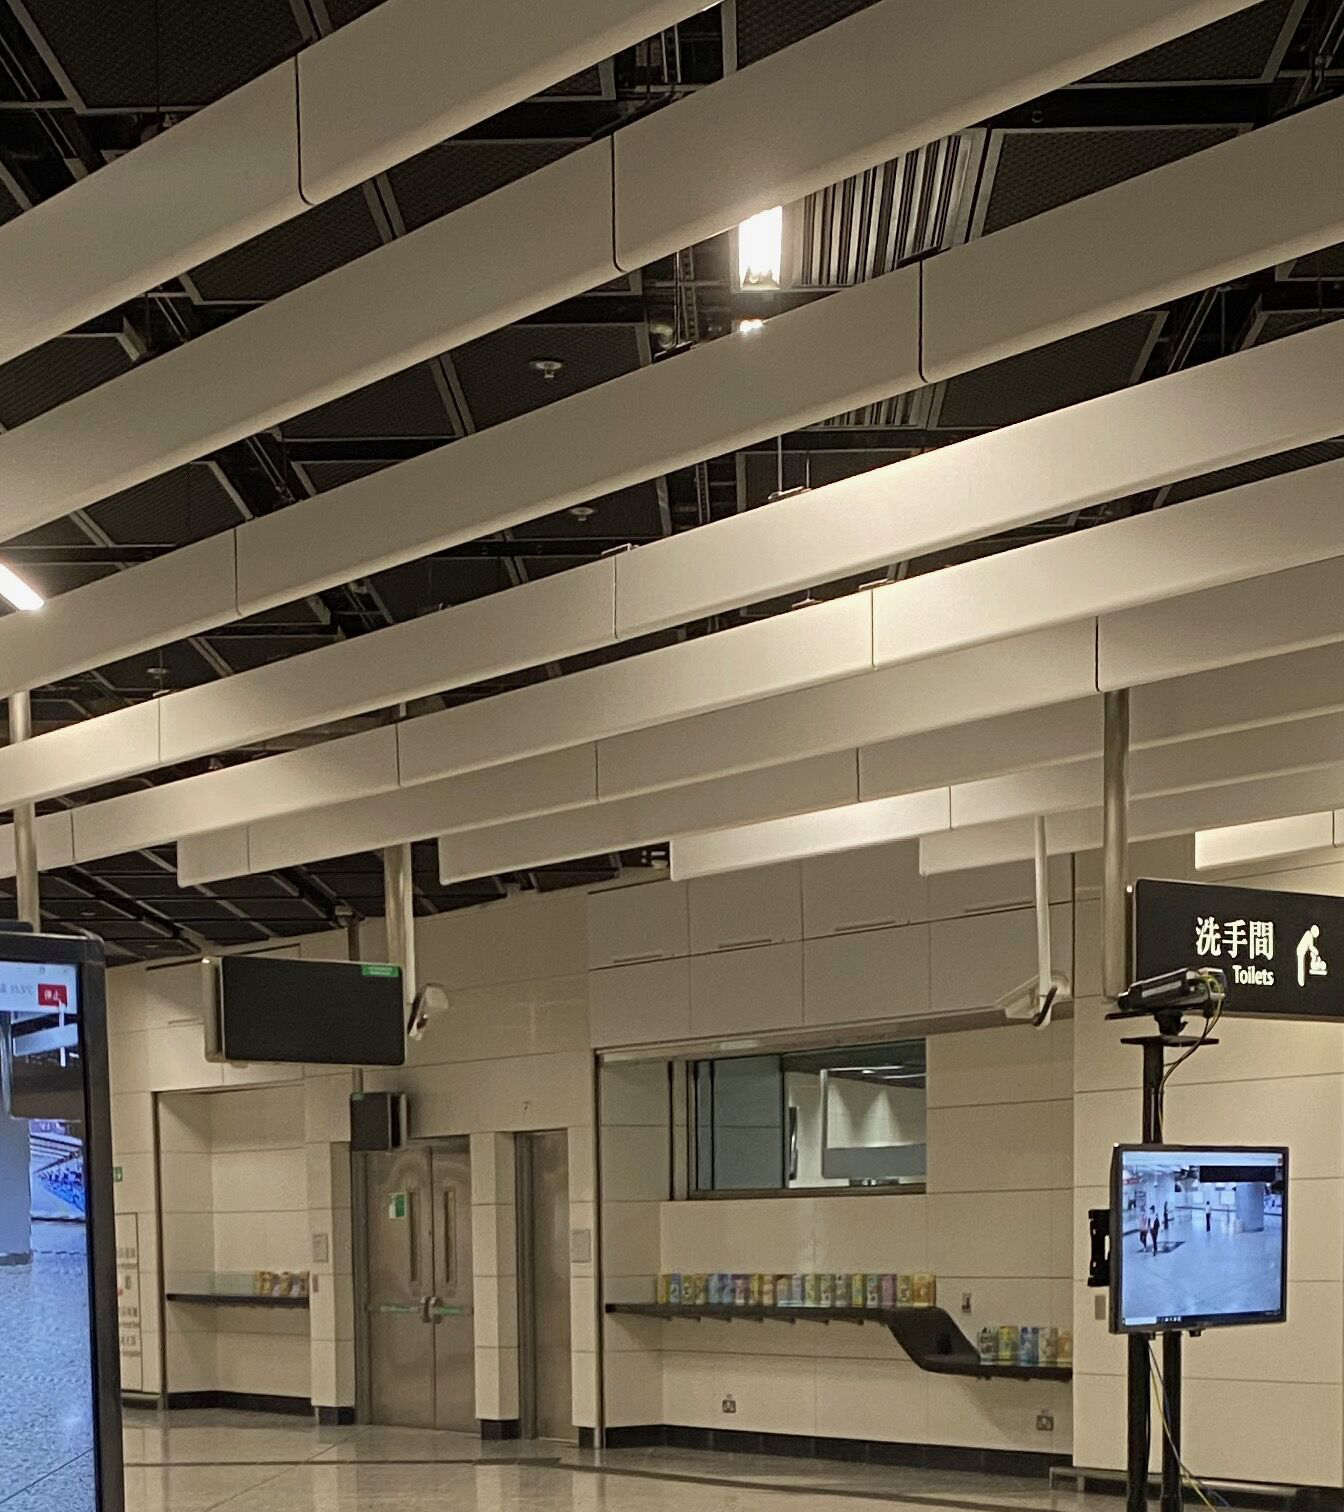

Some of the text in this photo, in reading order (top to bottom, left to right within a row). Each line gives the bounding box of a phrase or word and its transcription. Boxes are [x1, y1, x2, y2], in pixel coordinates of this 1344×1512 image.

[1195, 916, 1274, 960] 洗手間
[1232, 964, 1274, 987] Toilets
